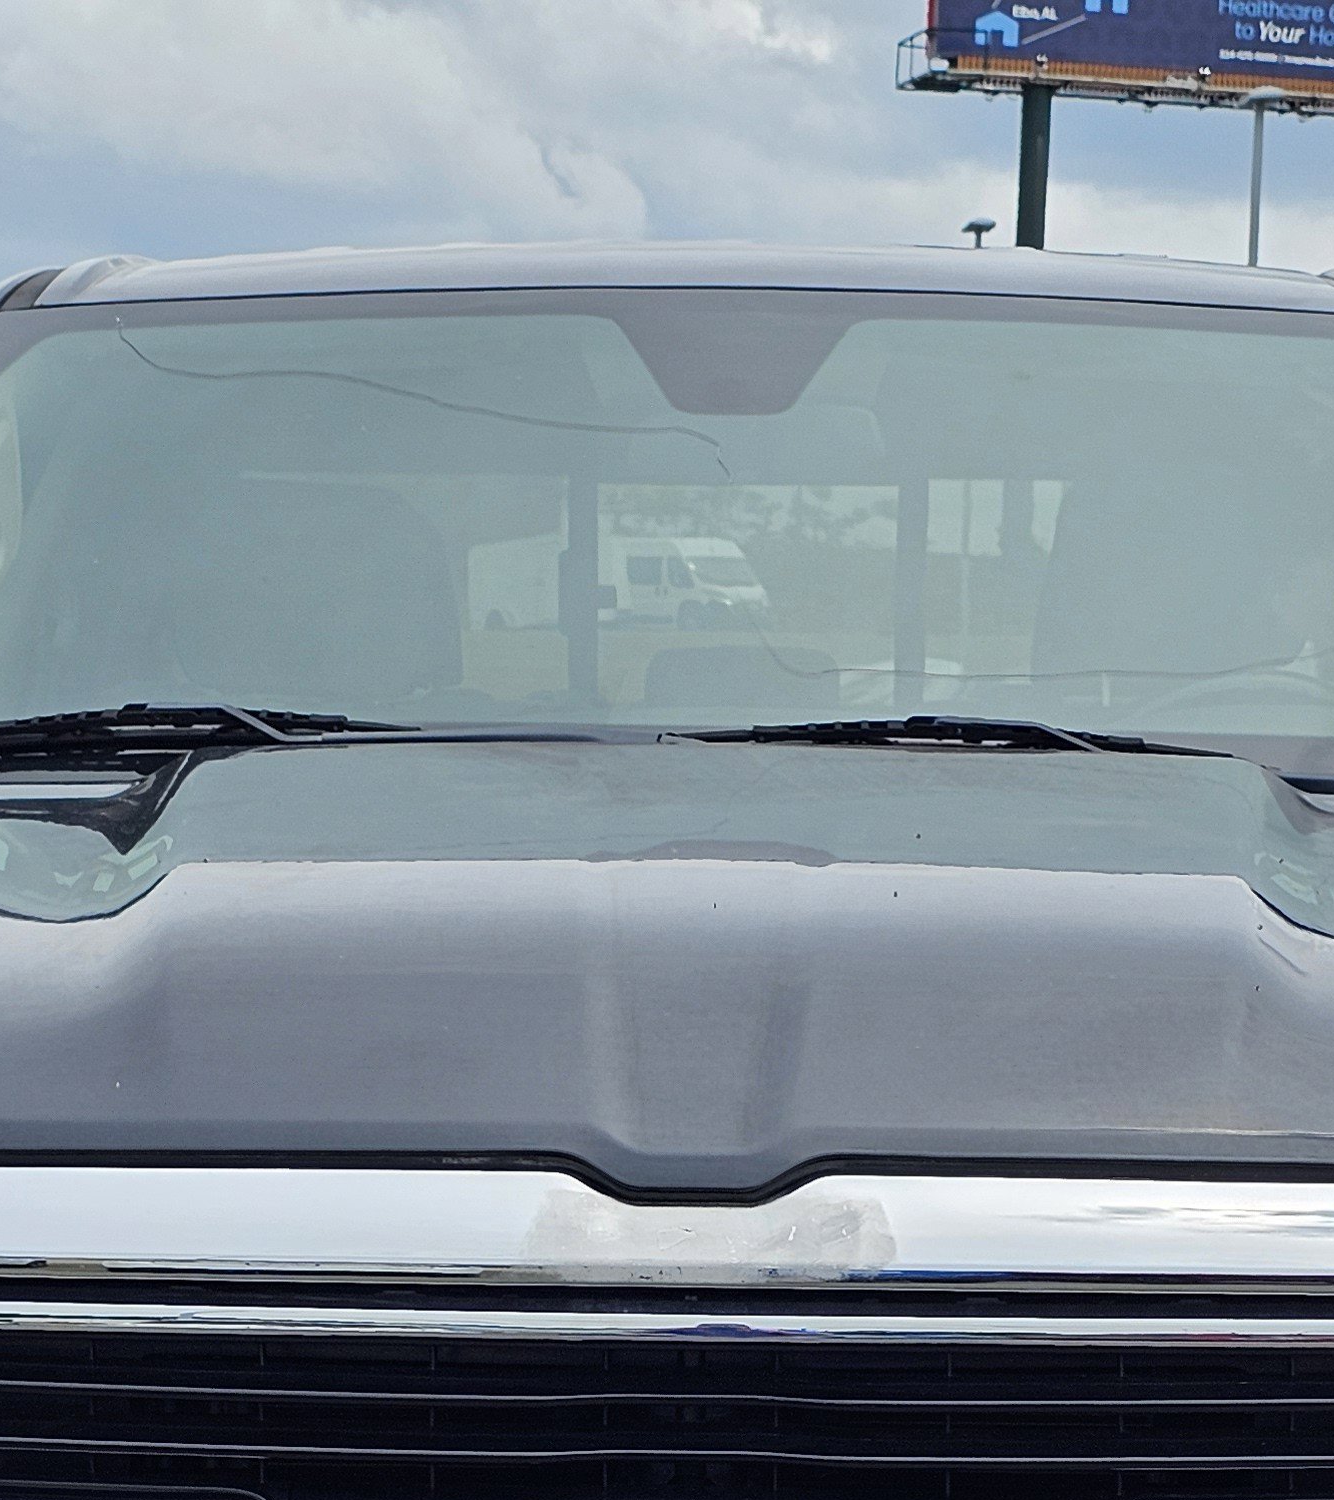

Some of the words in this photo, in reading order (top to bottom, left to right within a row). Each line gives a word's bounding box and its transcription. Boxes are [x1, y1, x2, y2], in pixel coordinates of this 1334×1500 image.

[1218, 0, 1325, 22] Healthcare
[1235, 21, 1255, 41] to
[1259, 20, 1306, 44] Your
